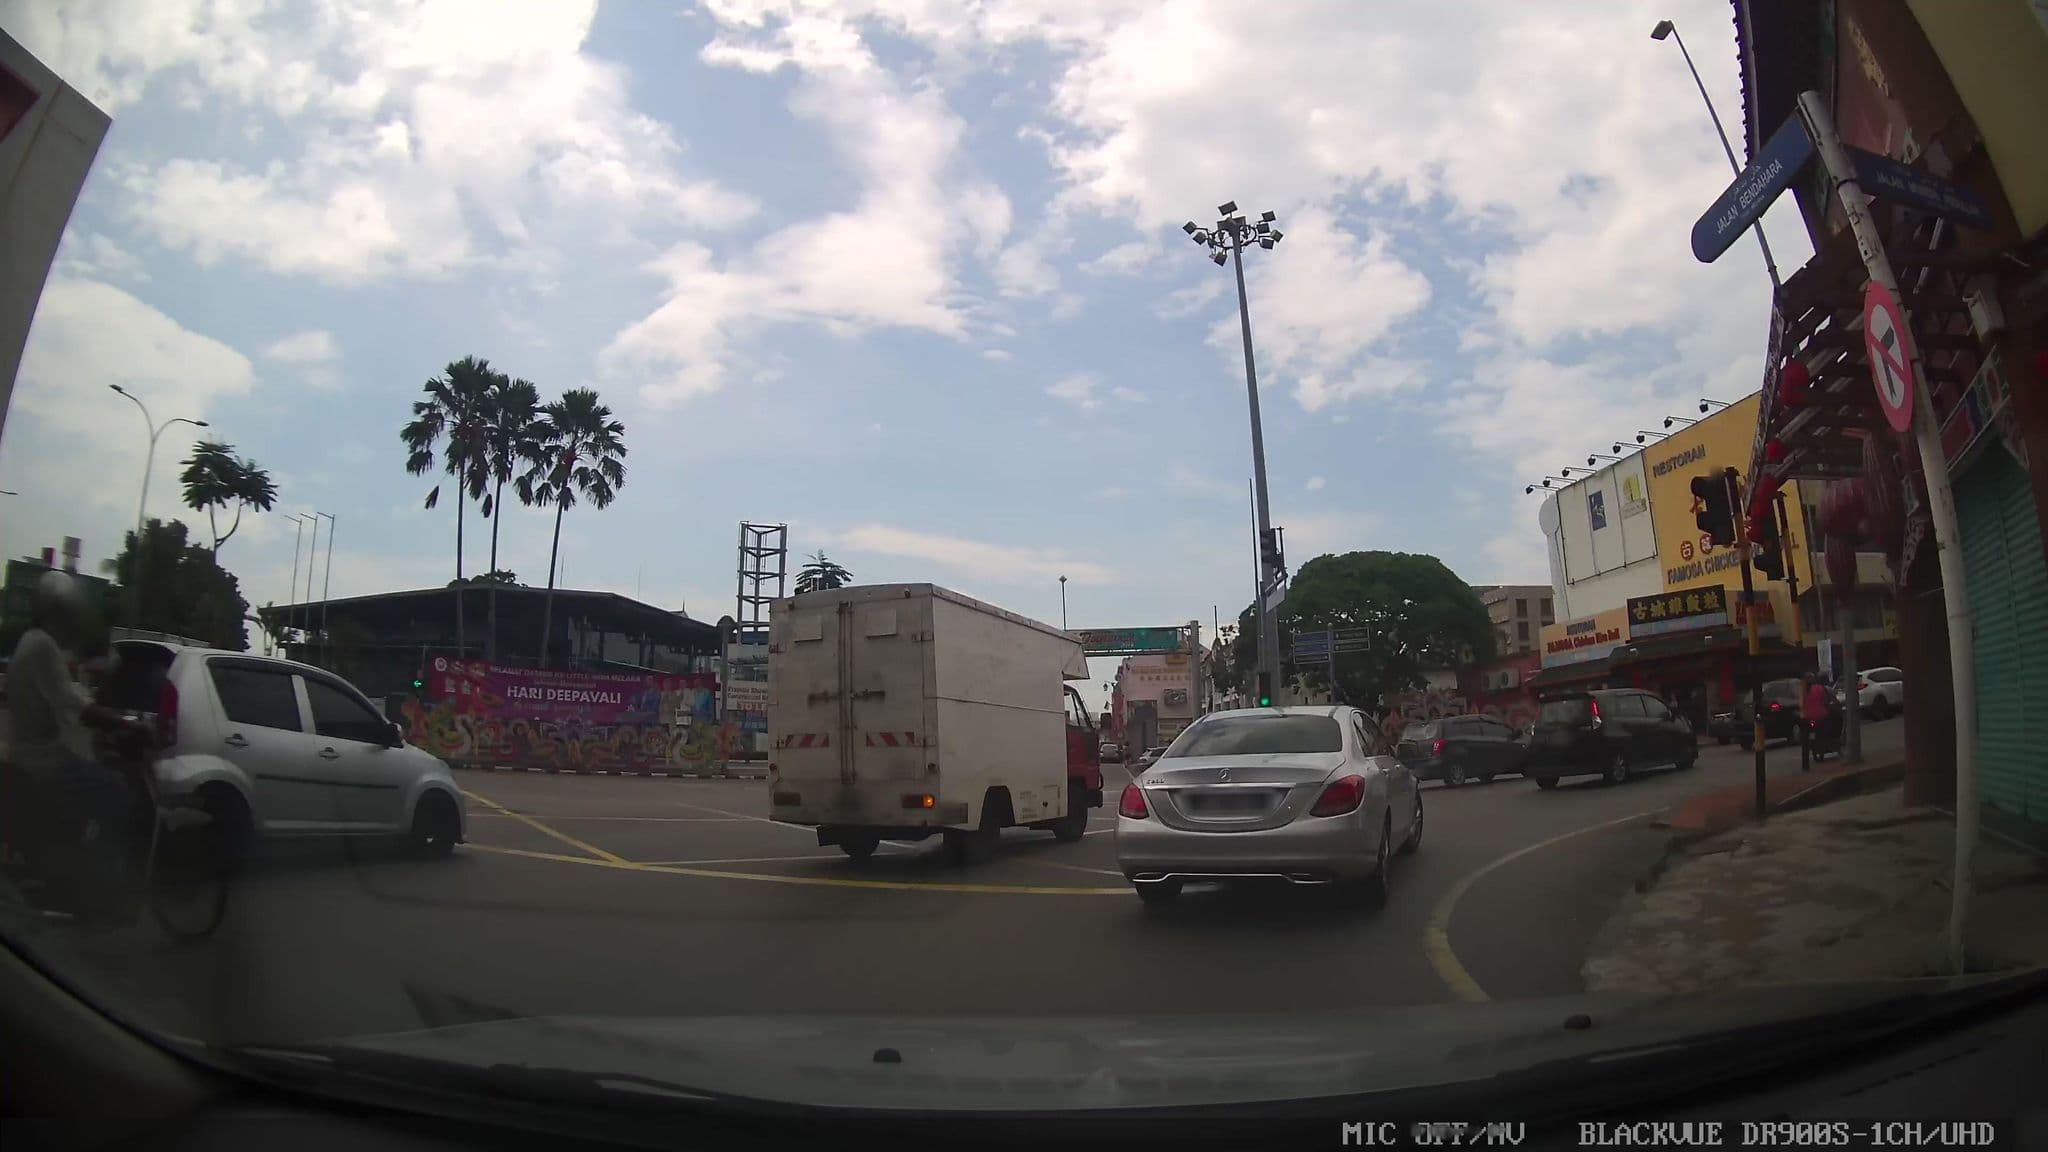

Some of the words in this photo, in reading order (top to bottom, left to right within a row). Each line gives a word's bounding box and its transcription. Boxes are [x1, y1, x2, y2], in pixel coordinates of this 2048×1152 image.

[1716, 204, 1739, 234] JALAN
[1739, 159, 1783, 209] BENDAHARA
[1652, 444, 1706, 478] RESTORAN
[1667, 562, 1704, 584] FAMOSA
[507, 686, 542, 700] HARI
[546, 689, 622, 704] DEEPAVALI
